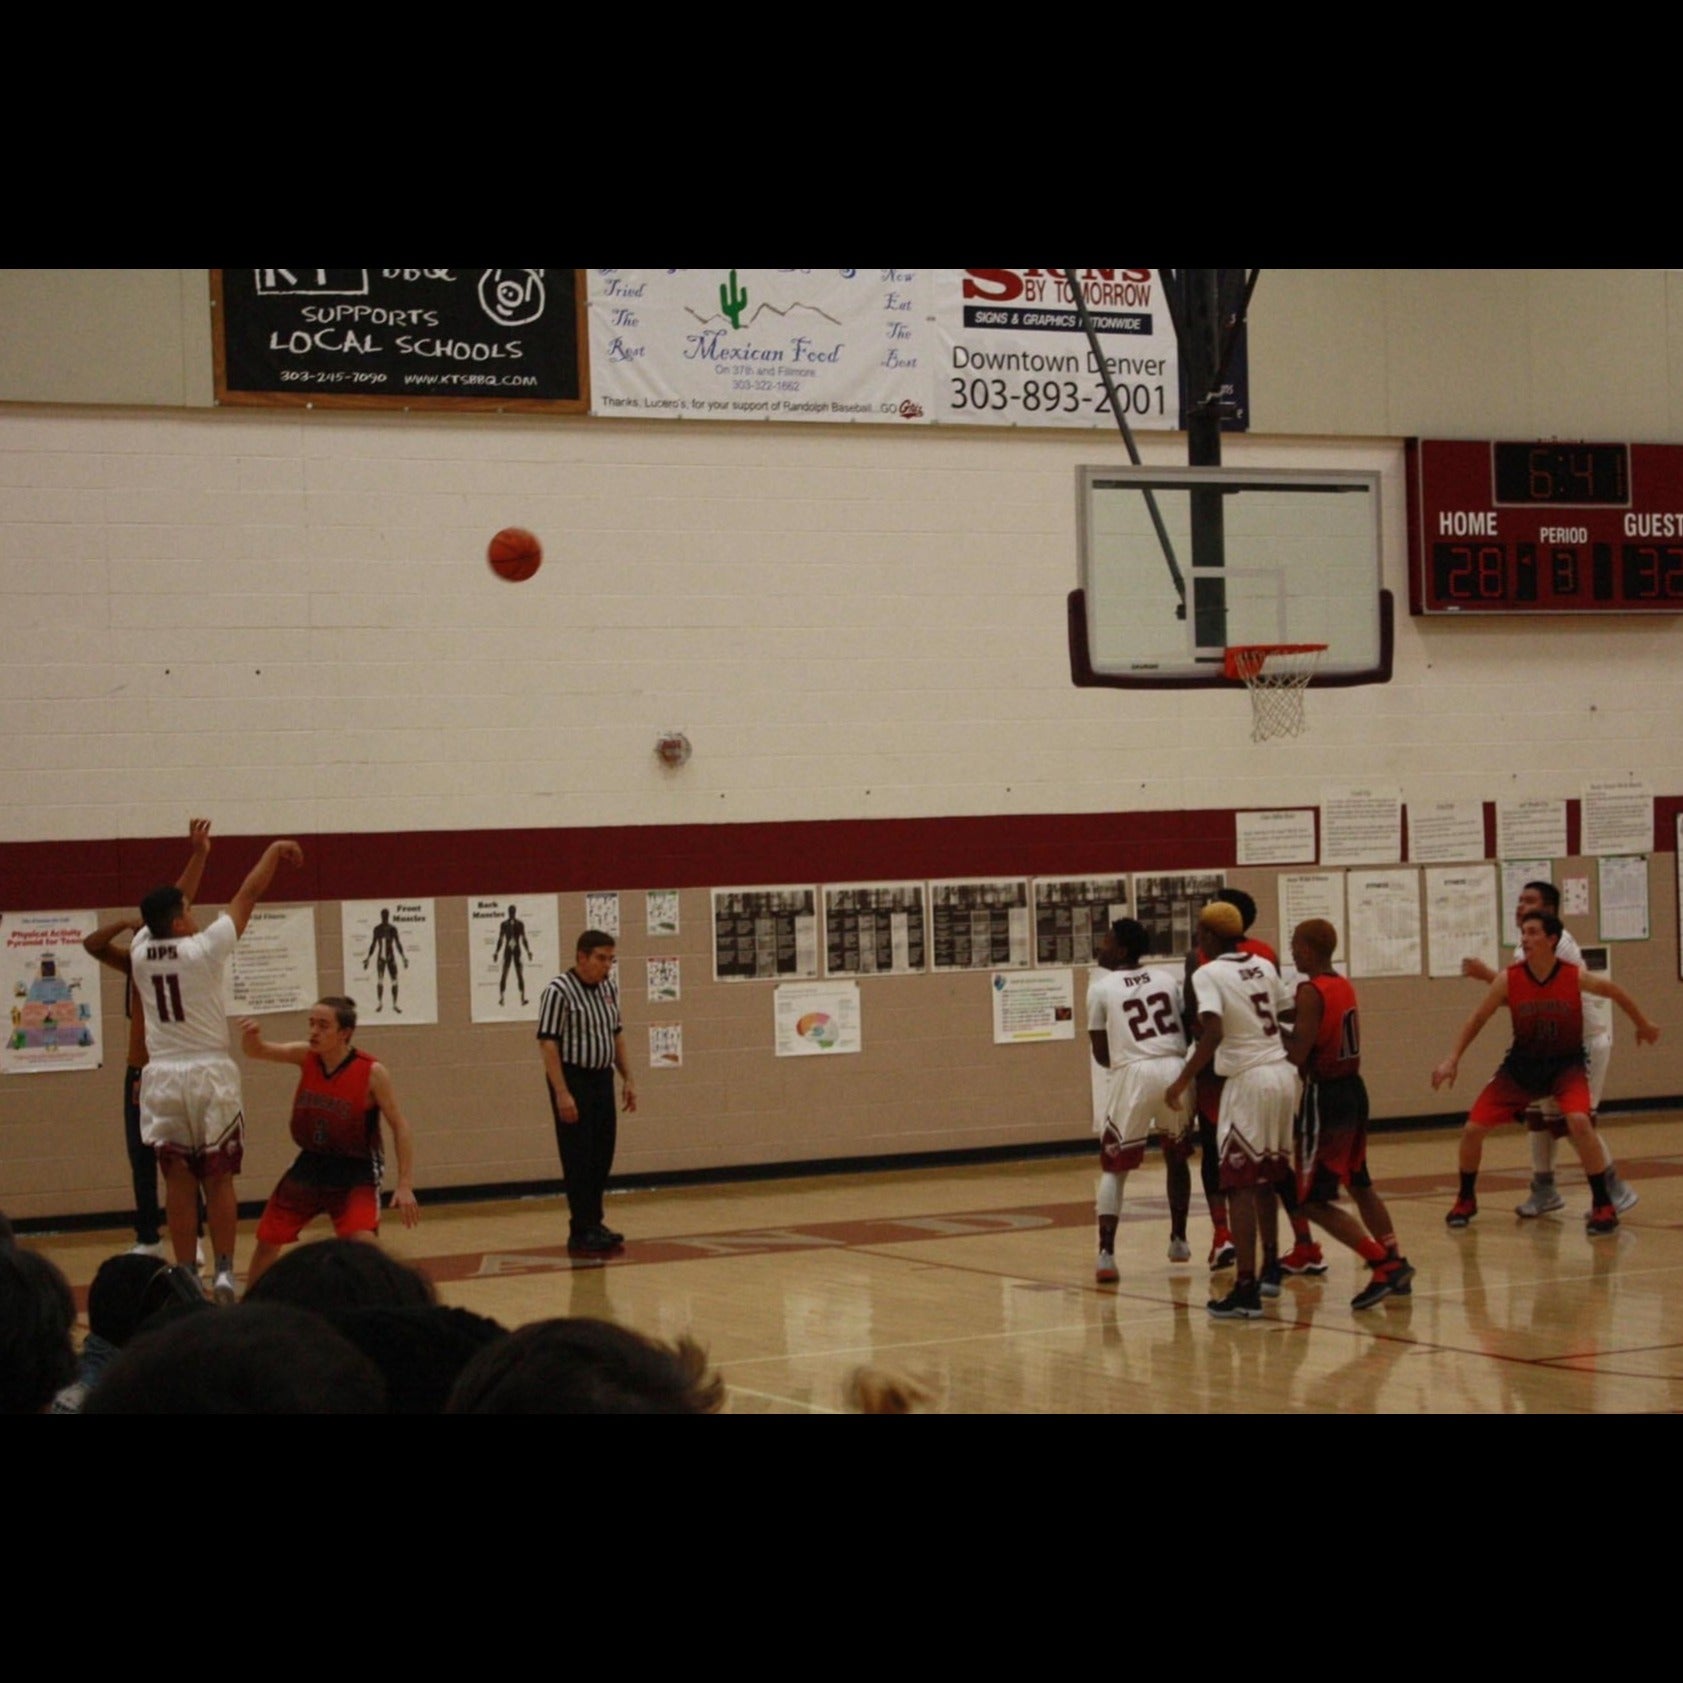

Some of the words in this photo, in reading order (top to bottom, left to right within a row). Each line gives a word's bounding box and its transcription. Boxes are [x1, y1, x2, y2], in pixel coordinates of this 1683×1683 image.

[604, 279, 646, 299] Tried
[1024, 279, 1046, 302] BY
[884, 291, 912, 312] Eat
[301, 304, 440, 327] SUPPORTS
[611, 309, 639, 328] The
[974, 311, 1008, 325] SIGNS
[1011, 312, 1018, 325] &
[1023, 313, 1076, 327] GRAPHICS
[1079, 314, 1142, 331] TIONWIDE
[886, 322, 912, 340] The
[269, 328, 383, 354] LOCAL
[394, 335, 524, 360] SCHOOLS
[684, 330, 783, 363] Mexican
[790, 336, 846, 363] Food
[880, 348, 918, 369] Best
[952, 346, 1079, 374] Downtown
[1087, 351, 1167, 376] Denver
[280, 369, 388, 385] 303-245-7090
[404, 372, 539, 387] WWW.KTSBBQ.COM
[757, 366, 775, 376] and
[692, 398, 705, 409] for
[708, 401, 729, 411] your
[733, 400, 769, 413] support
[771, 400, 780, 411] of
[783, 401, 829, 414] Randolph
[950, 378, 1164, 415] 303-893-2001
[1530, 448, 1623, 498] 6:41
[1439, 511, 1498, 537] HOME
[1624, 512, 1683, 538] GUEST
[1539, 526, 1588, 544] PERIOD
[1449, 547, 1503, 597] 28
[1557, 552, 1574, 592] 3
[1639, 548, 1683, 597] 32
[396, 904, 422, 913] Front
[472, 911, 506, 919] Muscles
[477, 901, 499, 910] Back
[392, 914, 426, 923] Muscles
[146, 945, 178, 960] DPS
[1123, 972, 1151, 987] DPS
[151, 973, 186, 1023] 11
[1122, 991, 1180, 1042] 22
[1249, 991, 1278, 1037] 5
